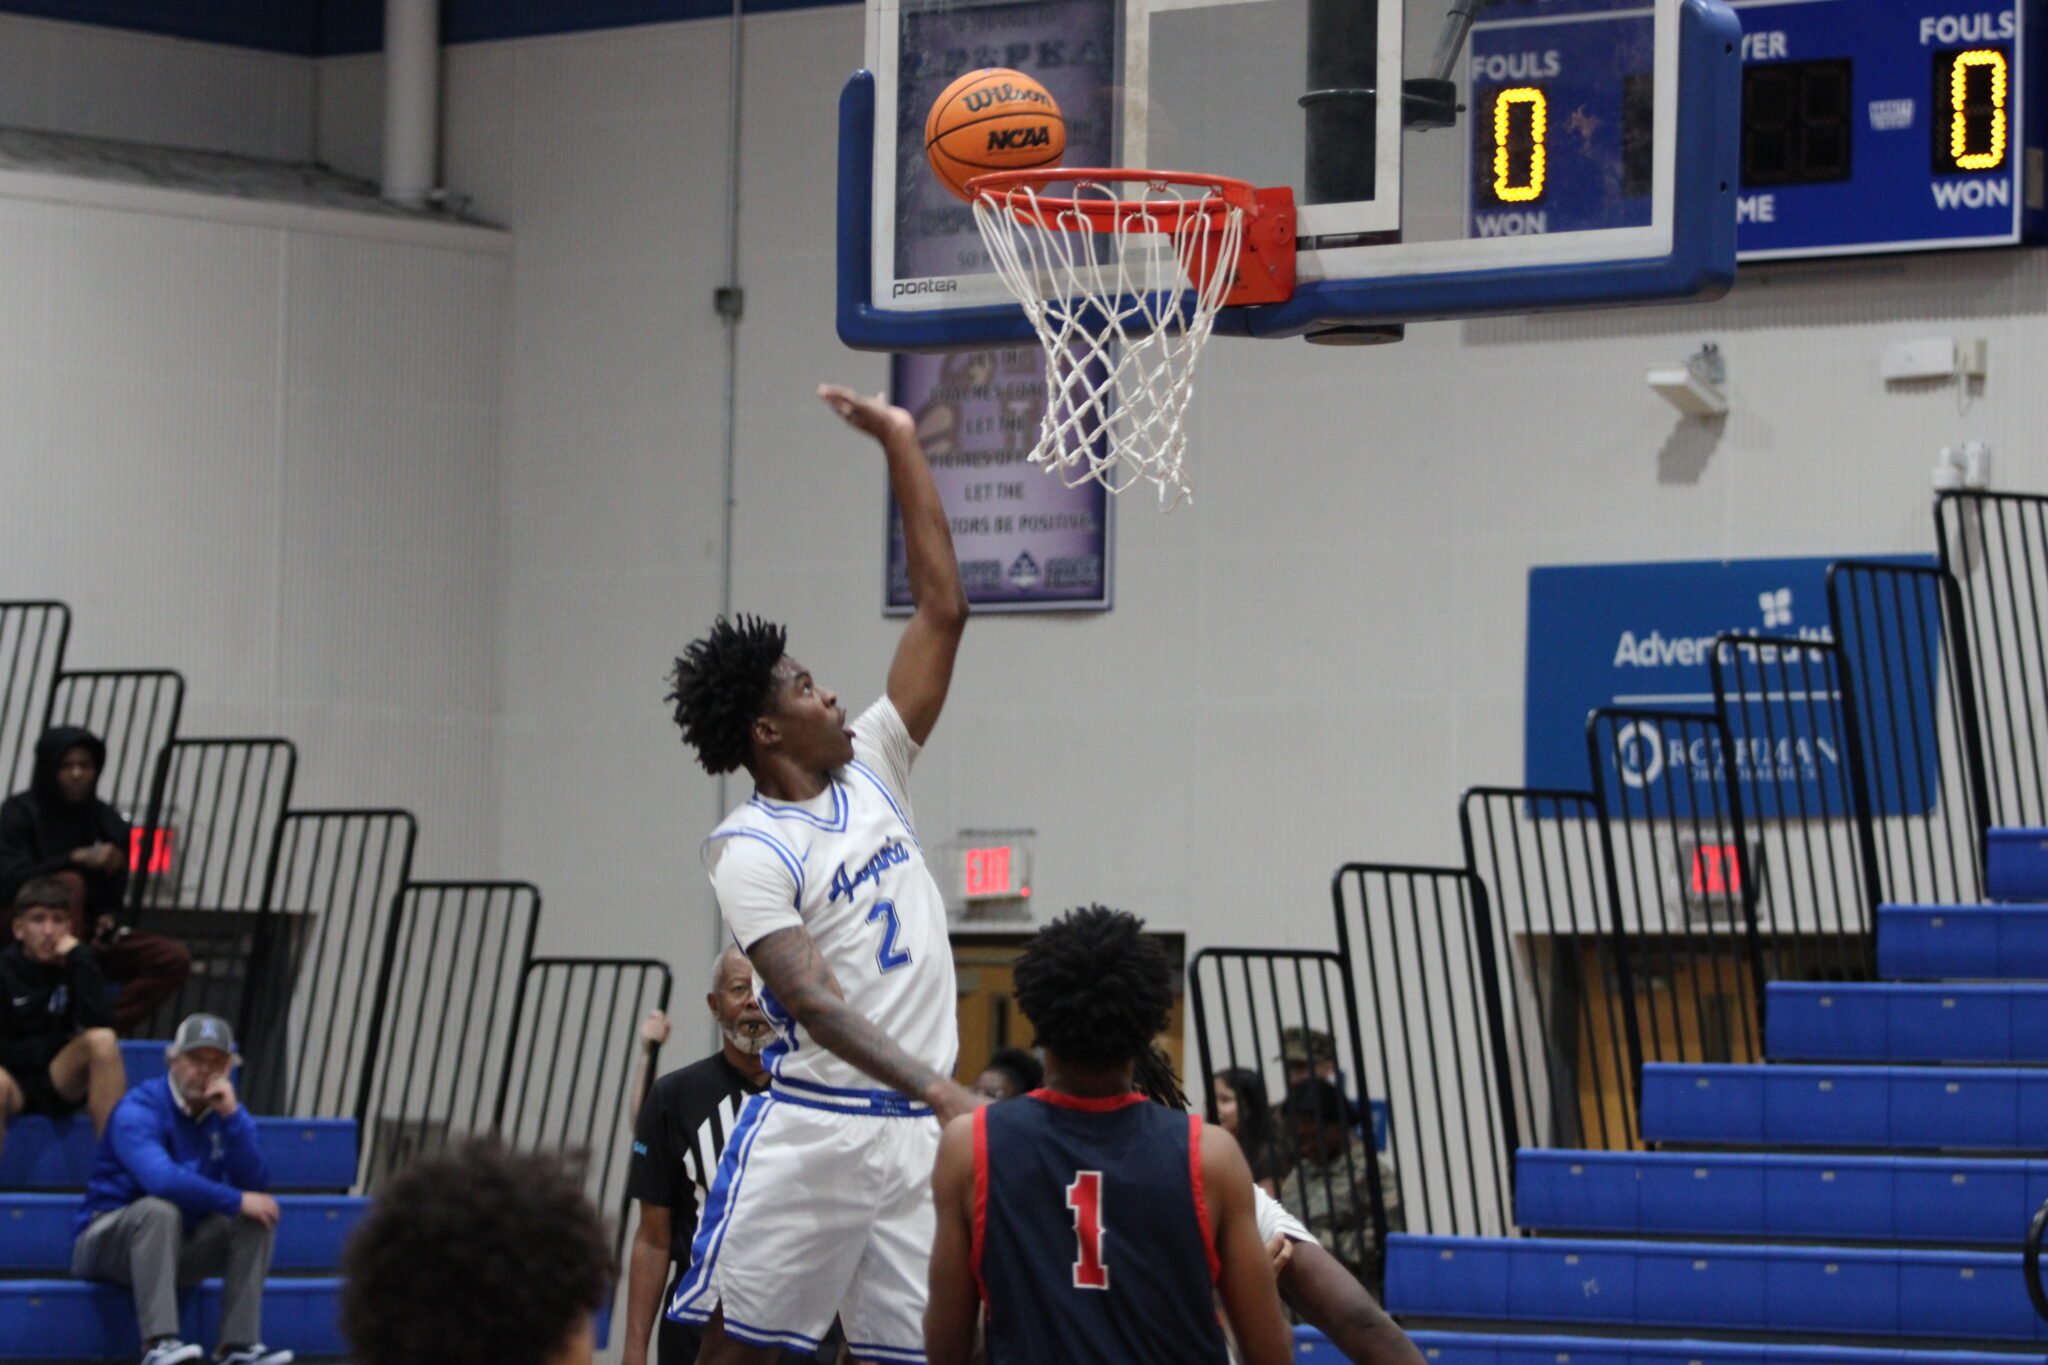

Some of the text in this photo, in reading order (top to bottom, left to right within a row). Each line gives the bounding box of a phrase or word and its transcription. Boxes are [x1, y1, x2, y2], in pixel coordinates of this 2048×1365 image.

[1919, 11, 2016, 44] FOULS
[1471, 51, 1561, 82] FOULS
[962, 83, 1052, 112] Wilson
[1951, 50, 2006, 169] 0
[987, 126, 1050, 151] NCAA
[1494, 87, 1547, 202] 0
[1931, 178, 2009, 210] WON
[1475, 210, 1547, 238] WON
[964, 481, 1024, 502] LET THE
[994, 515, 1014, 534] BE
[865, 898, 913, 974] 2
[1065, 1170, 1109, 1290] 1
